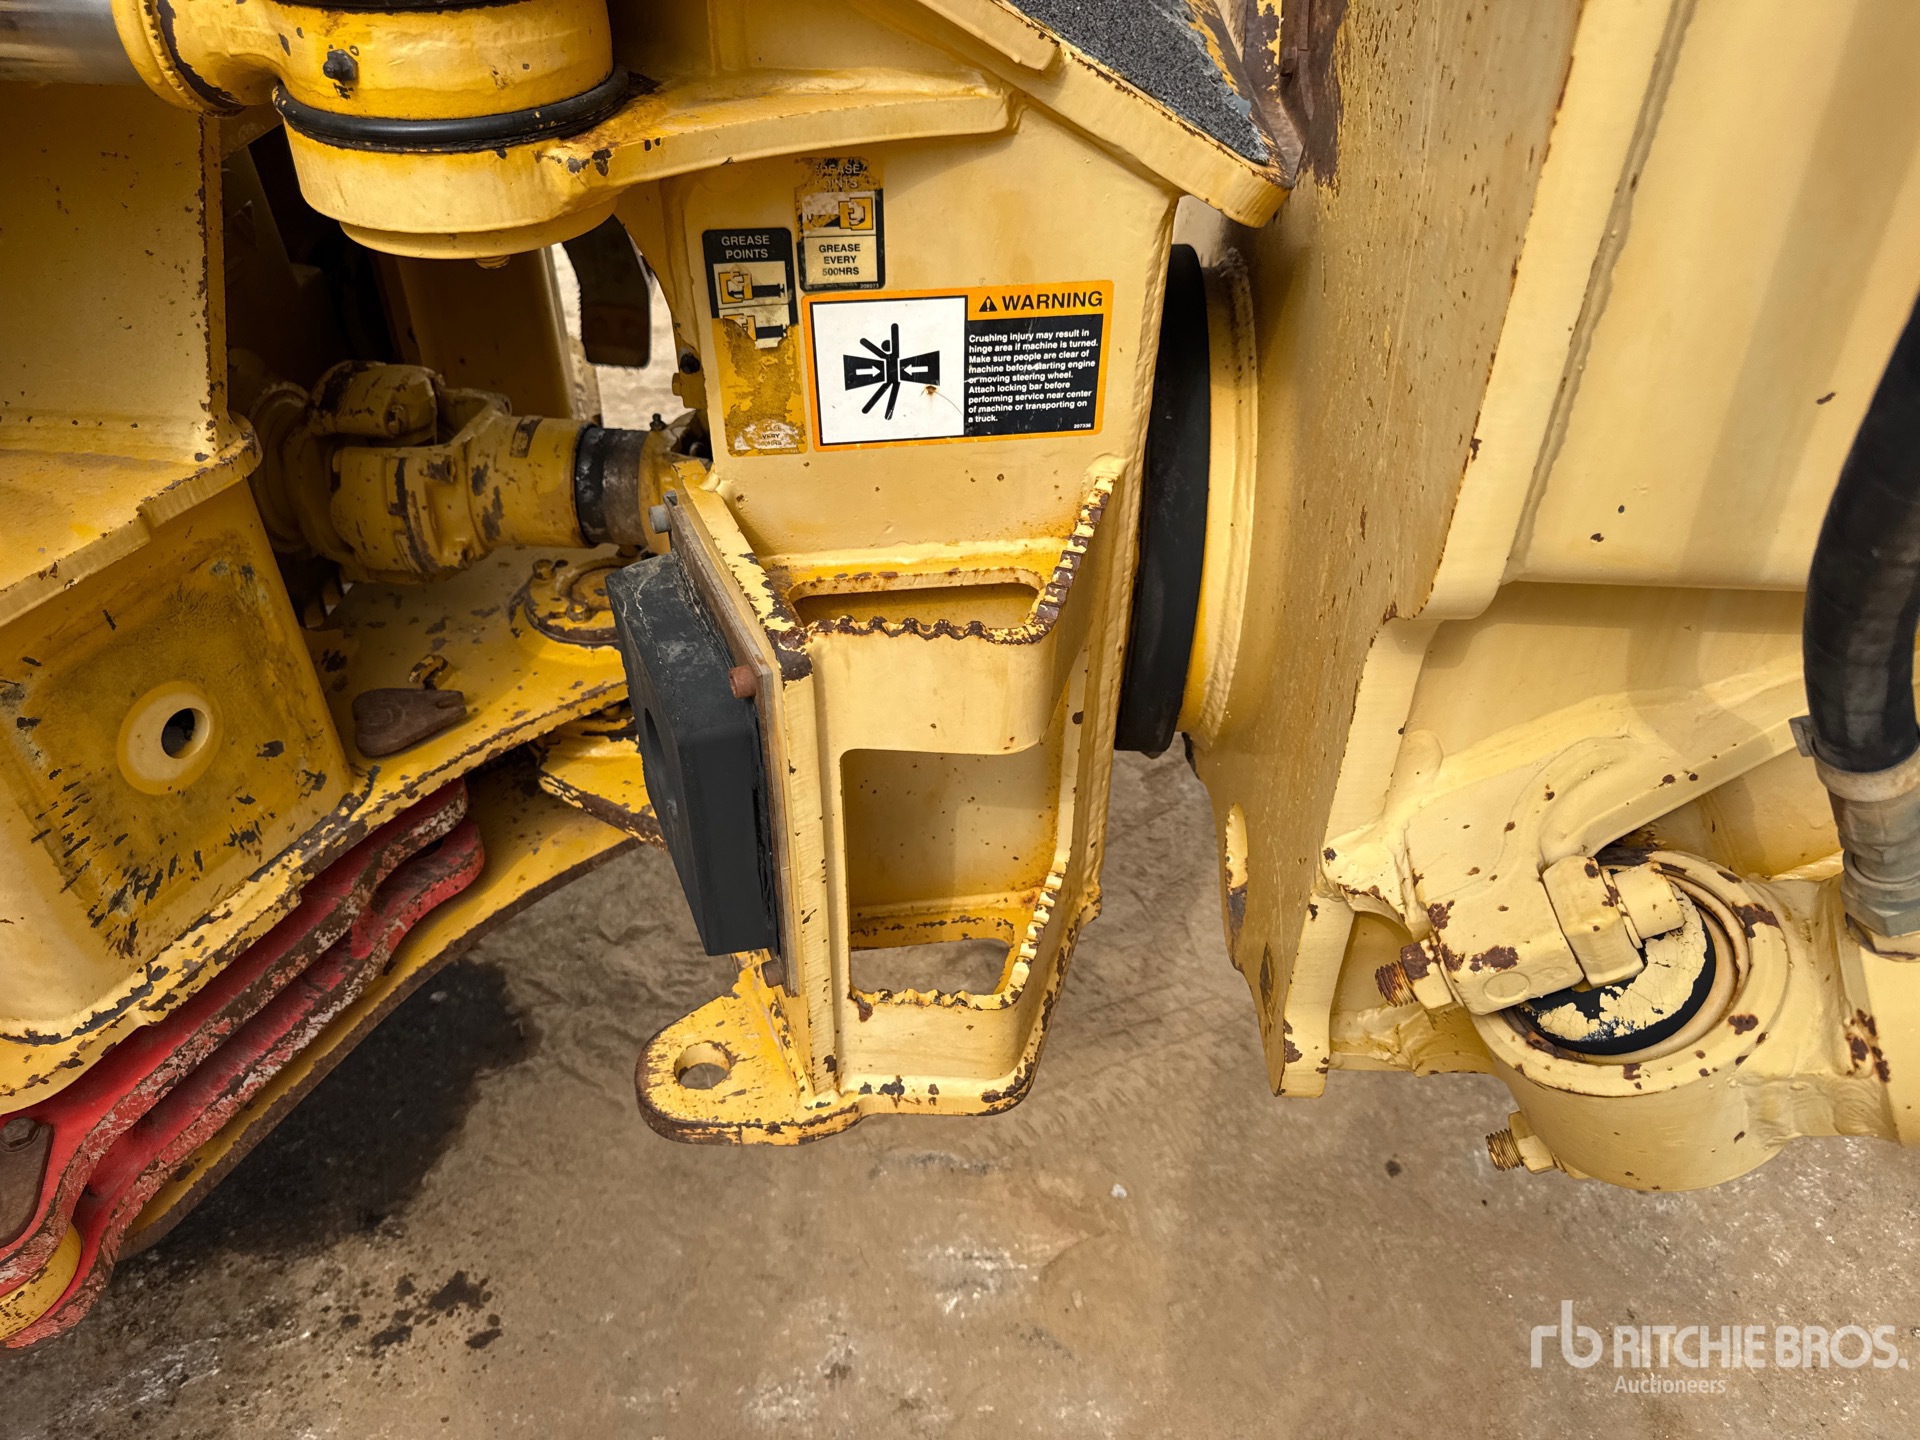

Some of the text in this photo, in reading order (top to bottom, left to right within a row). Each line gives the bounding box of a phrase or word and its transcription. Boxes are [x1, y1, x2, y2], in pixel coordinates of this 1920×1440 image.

[721, 235, 770, 246] GREASE
[819, 244, 861, 253] GREASE
[725, 249, 768, 260] POINTS
[824, 255, 857, 264] EVERY
[822, 266, 860, 277] 500HRS
[1002, 291, 1103, 311] WARNING
[969, 334, 1007, 343] Crushing
[1010, 333, 1033, 342] injury
[1036, 332, 1053, 340] may
[969, 345, 992, 354] hinge
[1023, 341, 1057, 350] machine
[1069, 339, 1098, 347] turned.
[1014, 353, 1041, 363] people
[969, 360, 1095, 373] machine before starting engine
[980, 375, 1010, 384] moving
[1013, 373, 1045, 382] steering
[969, 386, 995, 394] Attach
[998, 384, 1026, 393] locking
[968, 395, 1013, 405] performing
[1026, 400, 1075, 411] transporting
